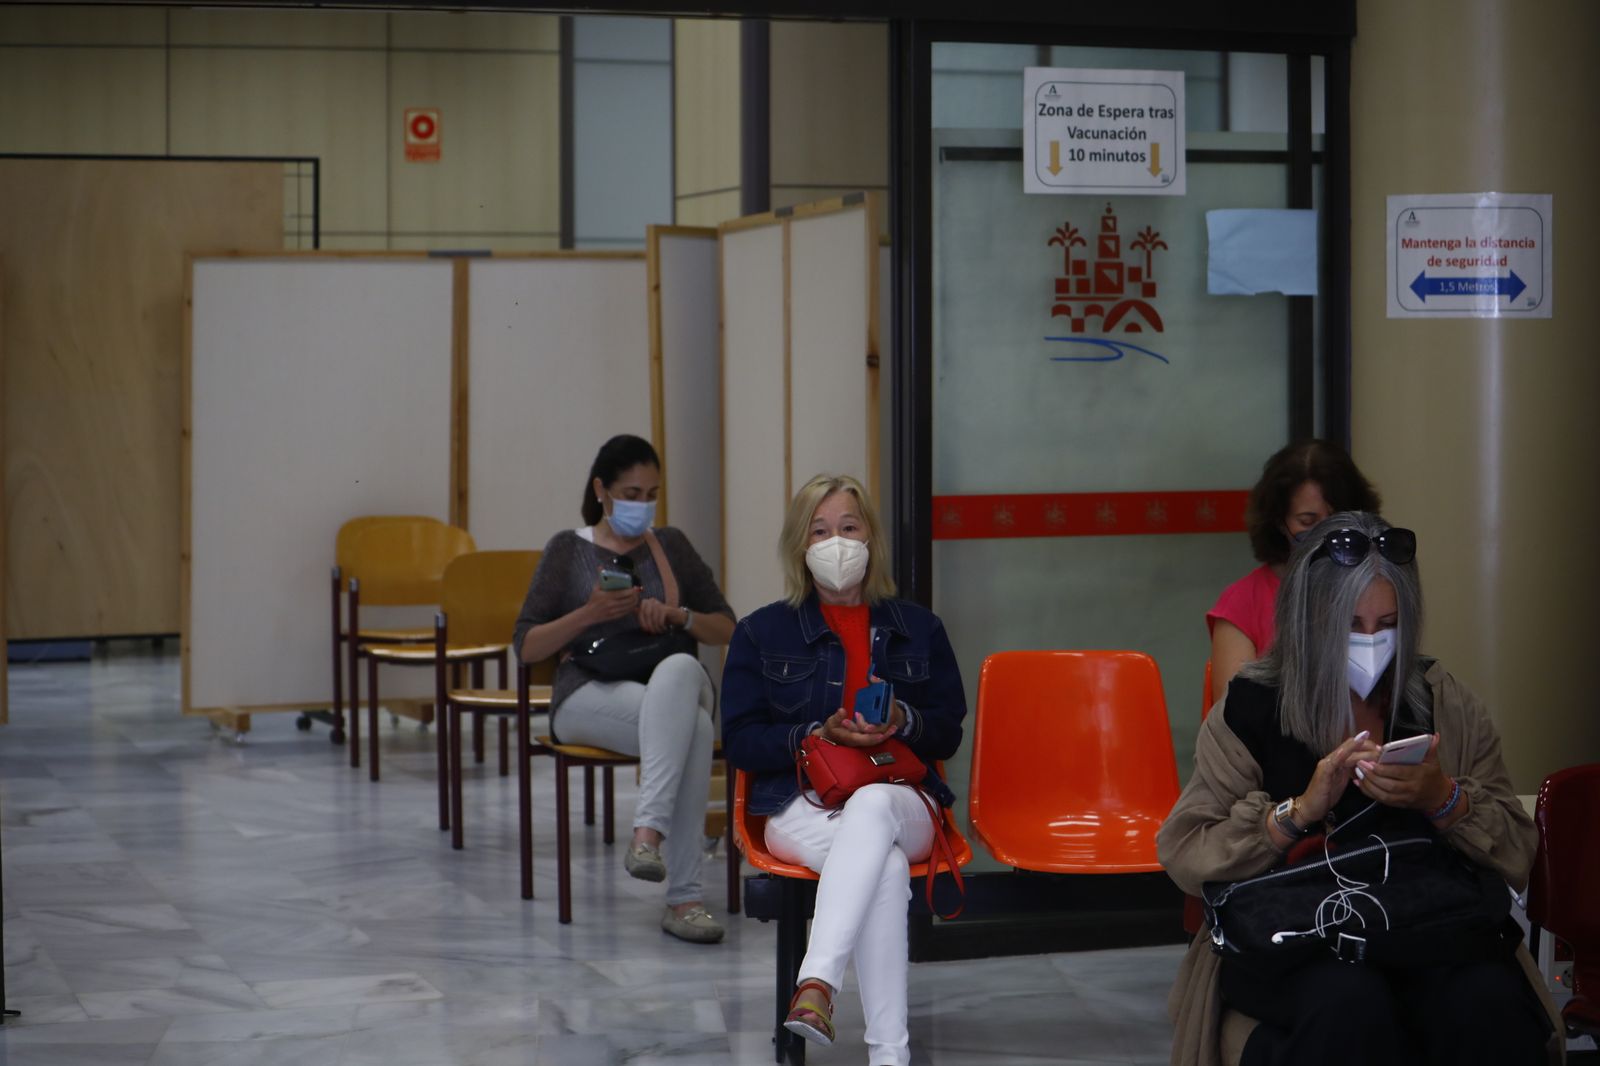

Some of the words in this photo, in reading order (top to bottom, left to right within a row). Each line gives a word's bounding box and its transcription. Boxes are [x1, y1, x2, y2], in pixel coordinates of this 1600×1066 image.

[1038, 103, 1073, 117] Zona
[1077, 104, 1094, 117] de
[1098, 105, 1144, 120] Espera
[1149, 107, 1174, 119] tras
[1067, 126, 1147, 140] Vacunación
[1069, 148, 1085, 162] 10
[1089, 149, 1146, 163] minutos
[1401, 238, 1461, 251] Mantenga
[1465, 237, 1476, 248] la
[1480, 236, 1536, 248] distancia
[1427, 256, 1441, 267] de
[1440, 282, 1455, 292] 1,5
[1457, 281, 1496, 292] Metros
